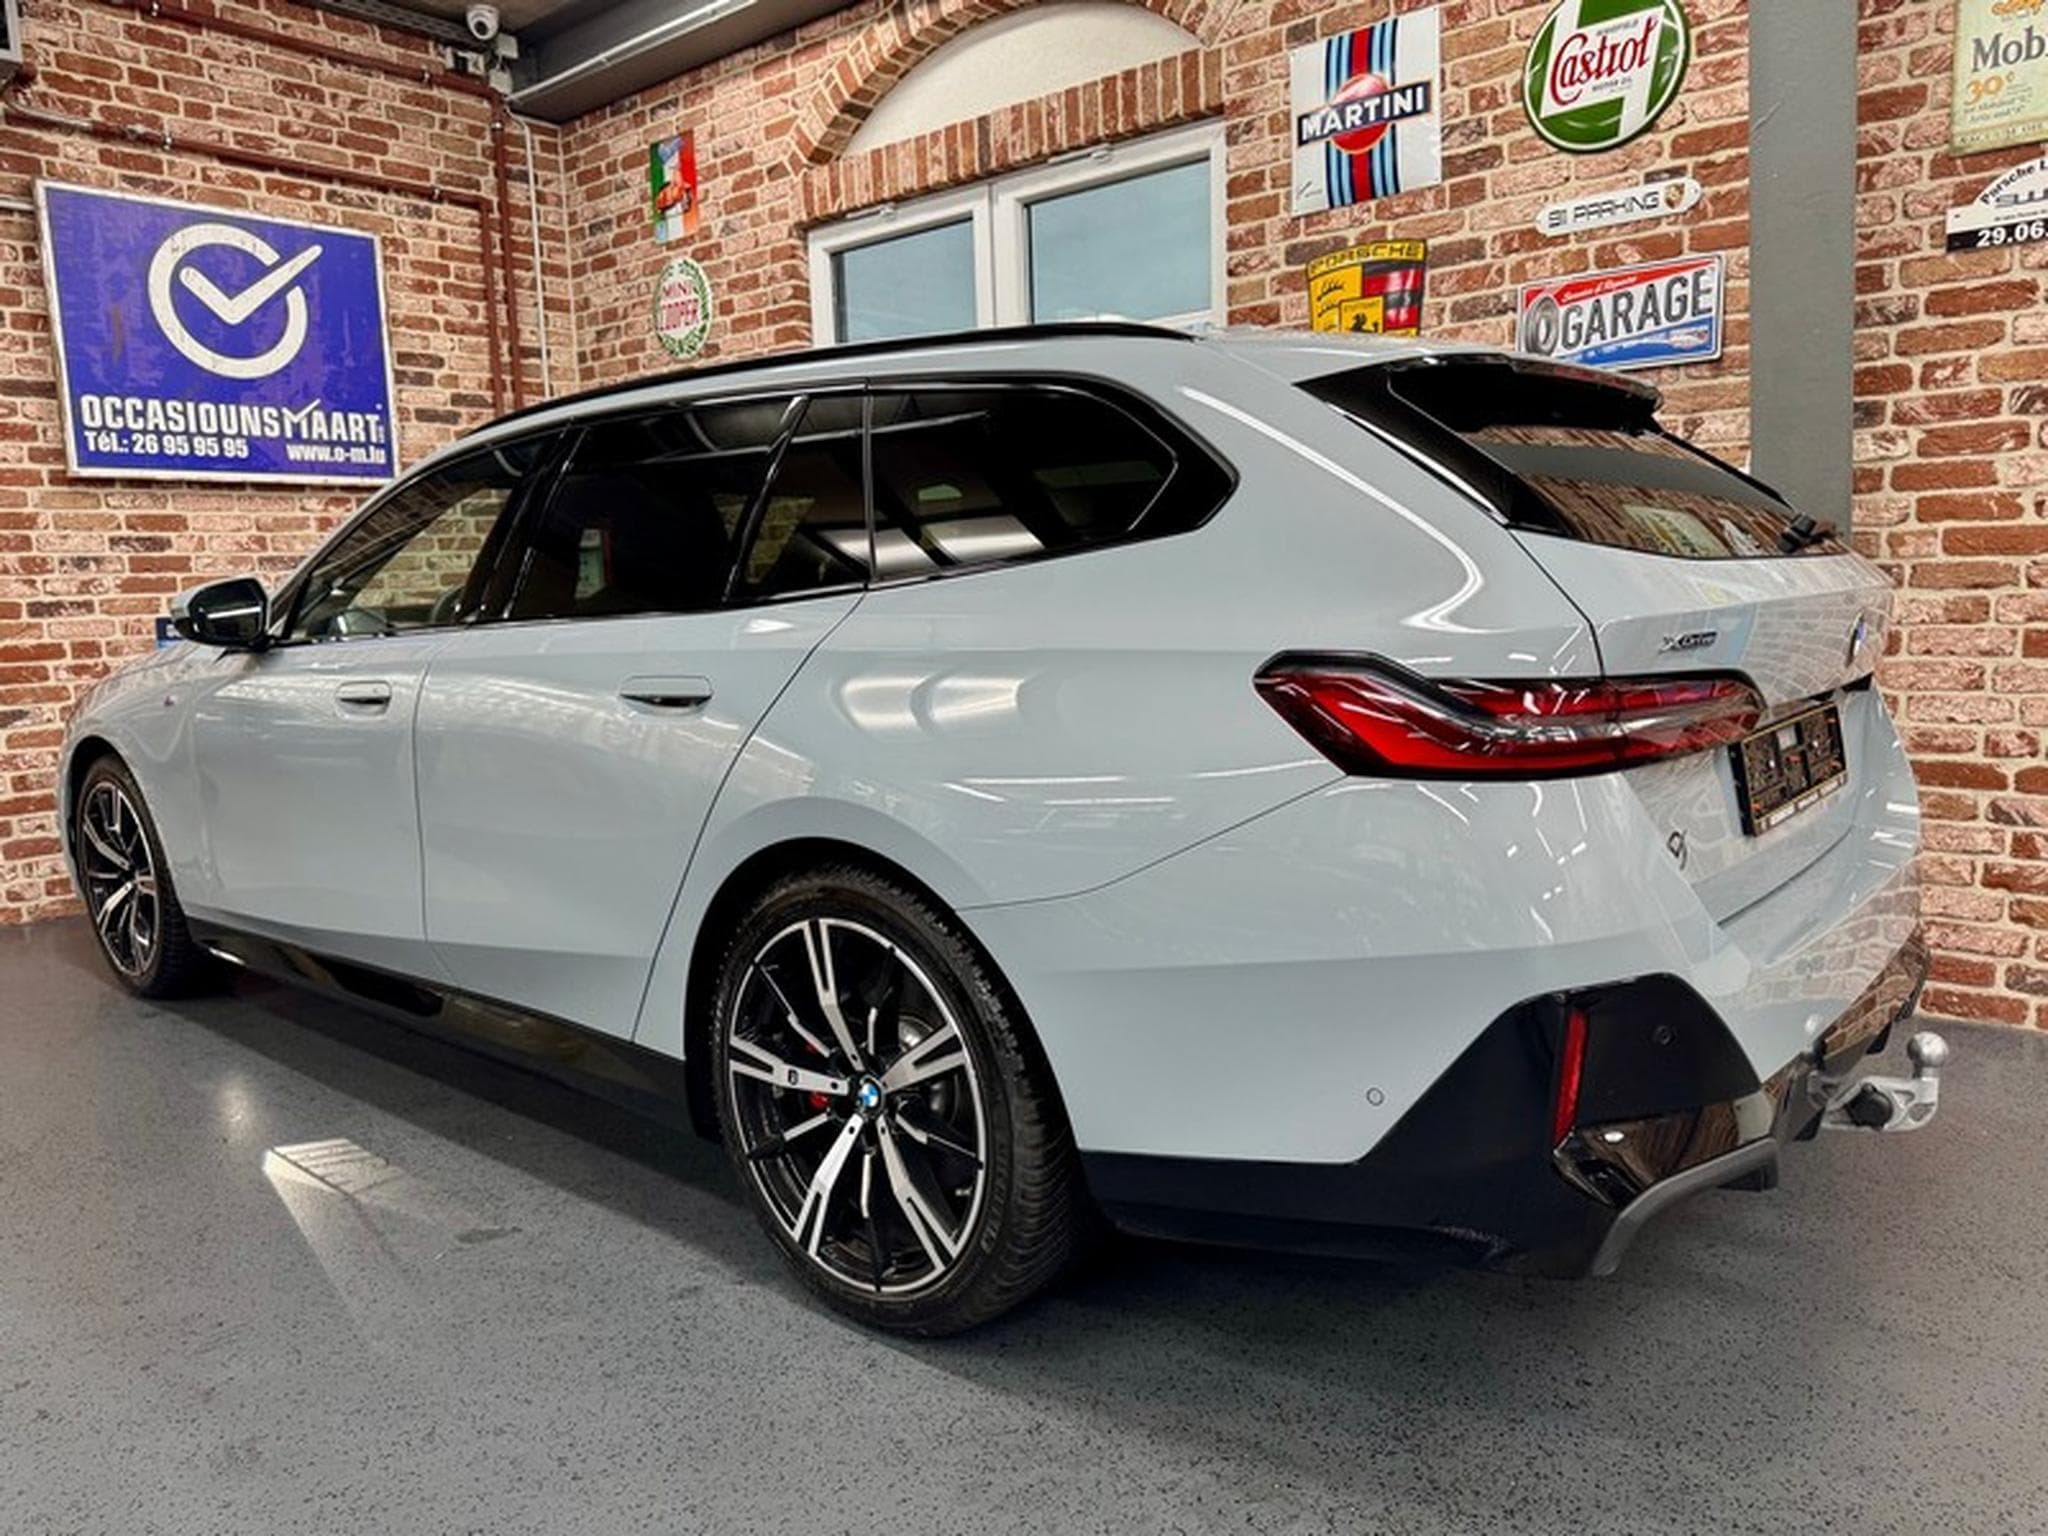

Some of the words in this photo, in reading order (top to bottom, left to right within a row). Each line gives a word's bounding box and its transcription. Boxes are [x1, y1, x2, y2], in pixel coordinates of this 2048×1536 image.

[1551, 15, 1658, 106] Castrol
[1971, 25, 2048, 73] Mob
[1302, 86, 1424, 141] MARTINI
[1573, 190, 1660, 223] PARKING
[1310, 241, 1423, 275] PORSCHE
[1562, 270, 1713, 349] GARAGE
[80, 394, 380, 443] OCCASIOUNSMAART
[131, 432, 159, 455] 26
[162, 434, 190, 456] 95
[193, 436, 219, 457] 95
[222, 437, 249, 459] 95
[286, 443, 386, 464] www.o-m.lu
